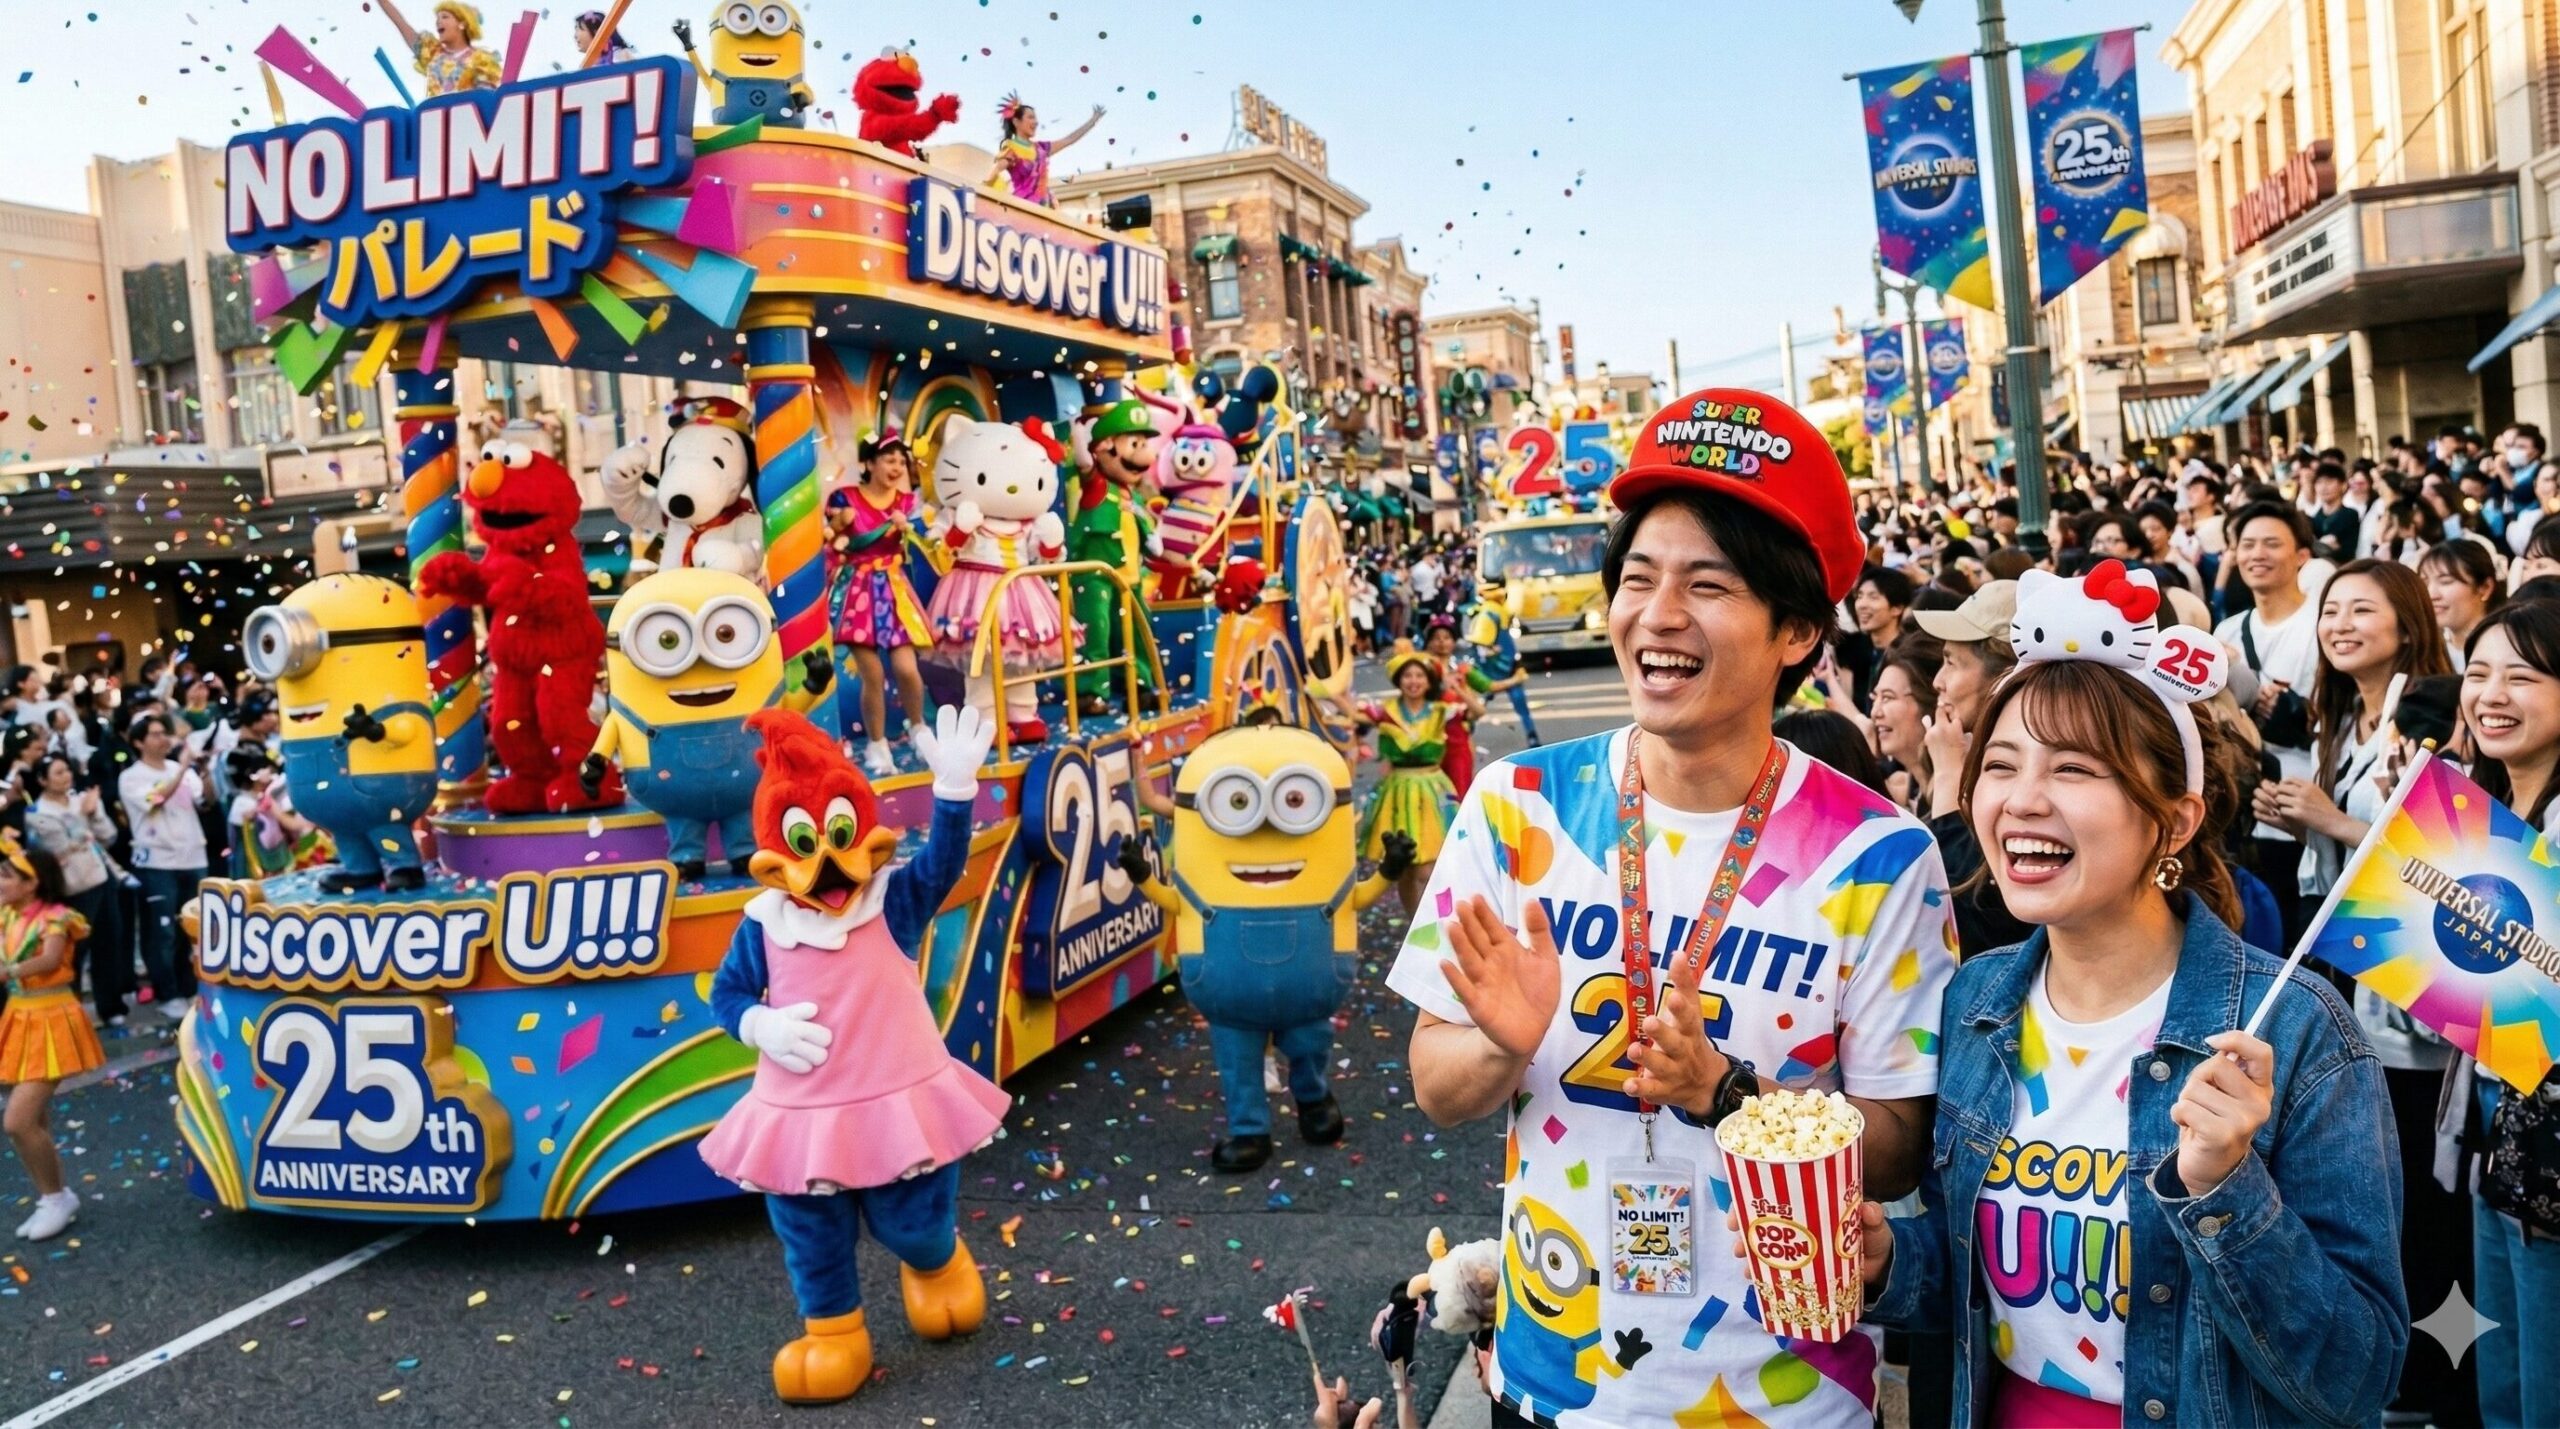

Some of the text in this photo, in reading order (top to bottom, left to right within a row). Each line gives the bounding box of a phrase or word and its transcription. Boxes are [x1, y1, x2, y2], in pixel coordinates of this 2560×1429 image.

[228, 67, 664, 234] NO LIMIT!
[2055, 124, 2131, 170] 25th
[328, 189, 585, 310] パレード
[926, 177, 1165, 333] Discover U!!!
[1692, 400, 1762, 426] SUPER
[1506, 421, 1616, 498] 25
[1657, 420, 1792, 460] NINTENDO
[1670, 444, 1761, 475] WORLD
[2157, 638, 2215, 685] 25
[2400, 856, 2502, 934] UNIVERSAL
[201, 873, 662, 977] Discover U!!!
[1057, 902, 1160, 982] ANNIVERSARY
[2443, 916, 2510, 963] JAPAN
[262, 1010, 476, 1154] 25th
[260, 1159, 472, 1196] ANNIVERSARY
[1618, 1209, 1684, 1223] NO LIMIT!
[1755, 1225, 1796, 1244] POP
[1758, 1241, 1810, 1262] CORN
